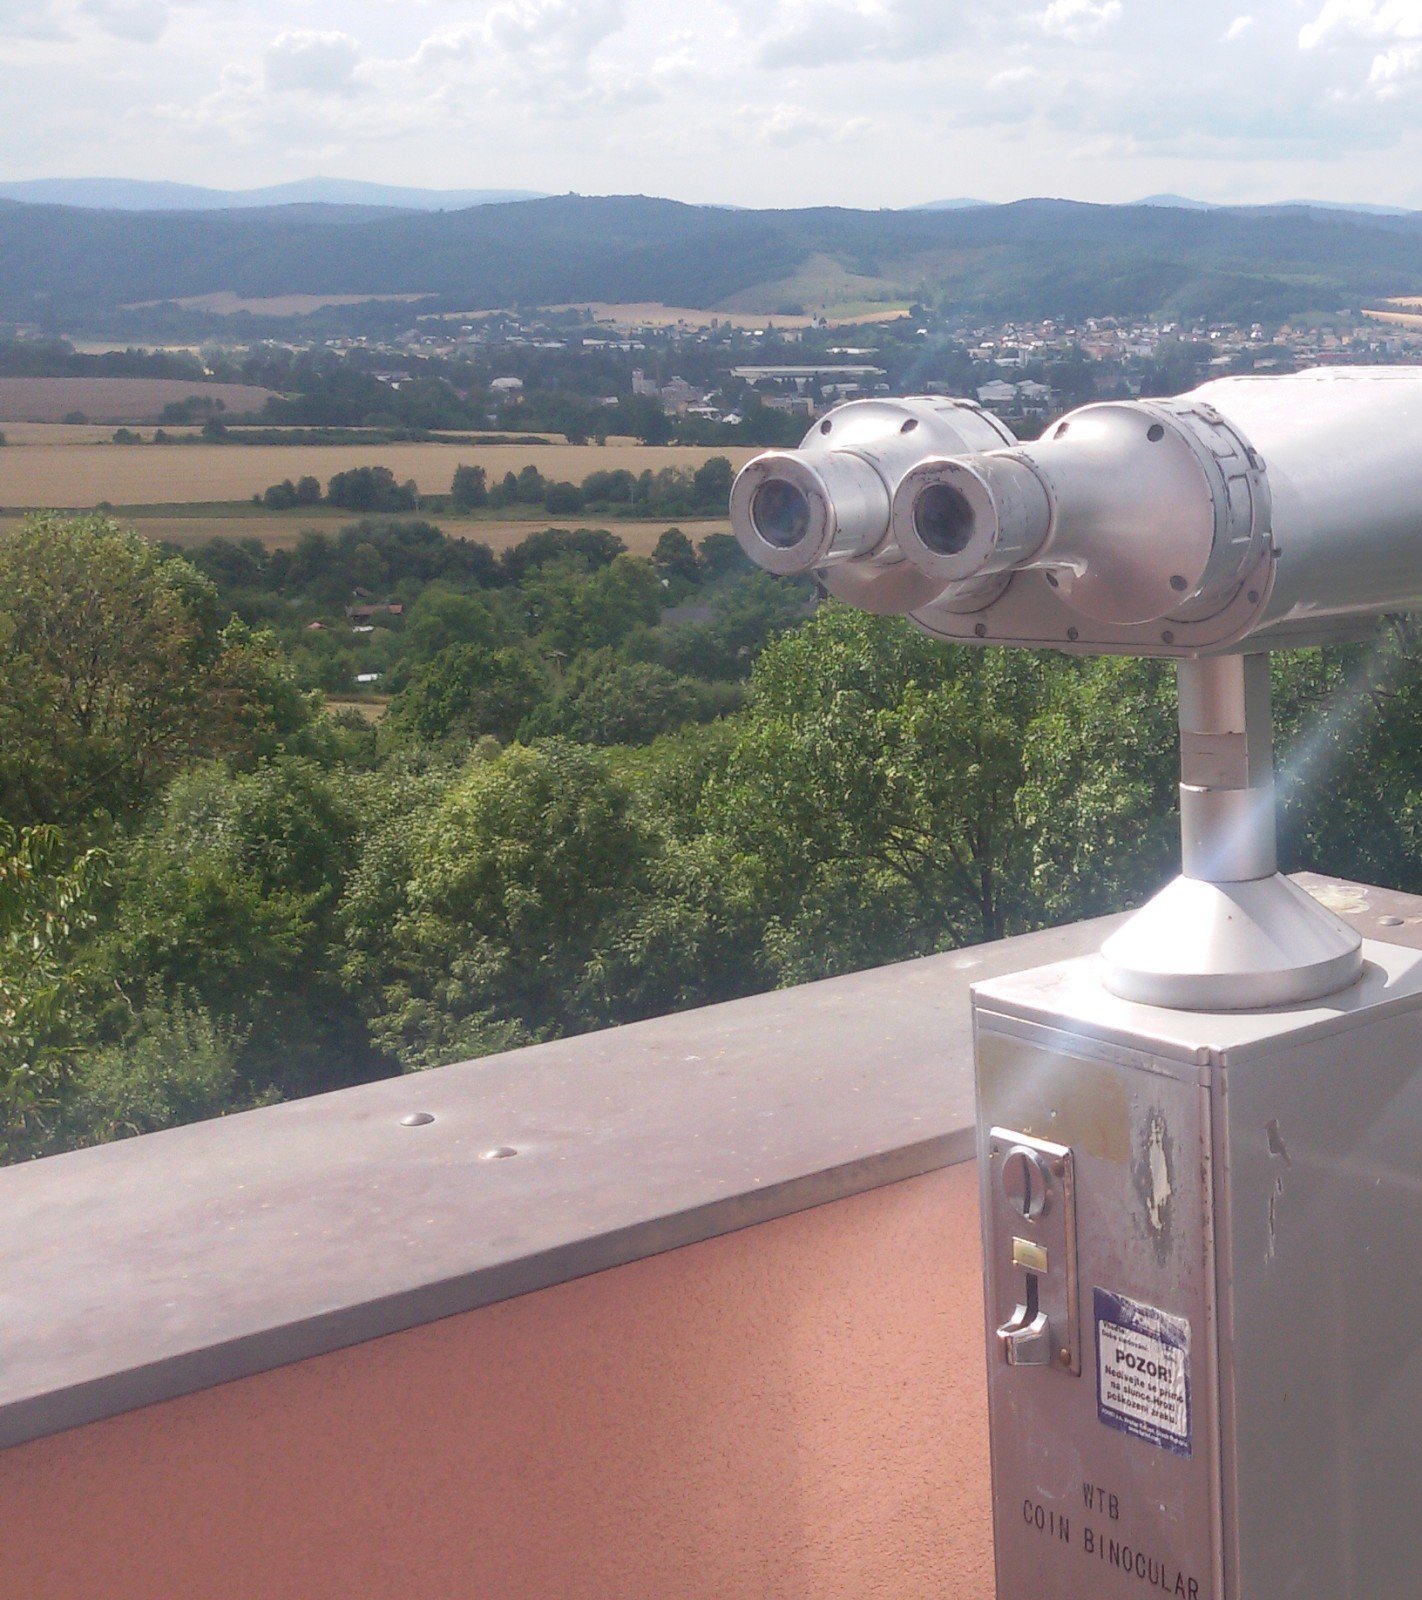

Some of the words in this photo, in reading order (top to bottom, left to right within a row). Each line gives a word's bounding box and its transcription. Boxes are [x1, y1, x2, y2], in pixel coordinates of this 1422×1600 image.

[1115, 1348, 1172, 1384] POZOR!
[1110, 1381, 1121, 1391] na
[1083, 1482, 1119, 1520] WTB
[1023, 1499, 1070, 1543] COIN
[1084, 1527, 1199, 1600] BINOCULAR
